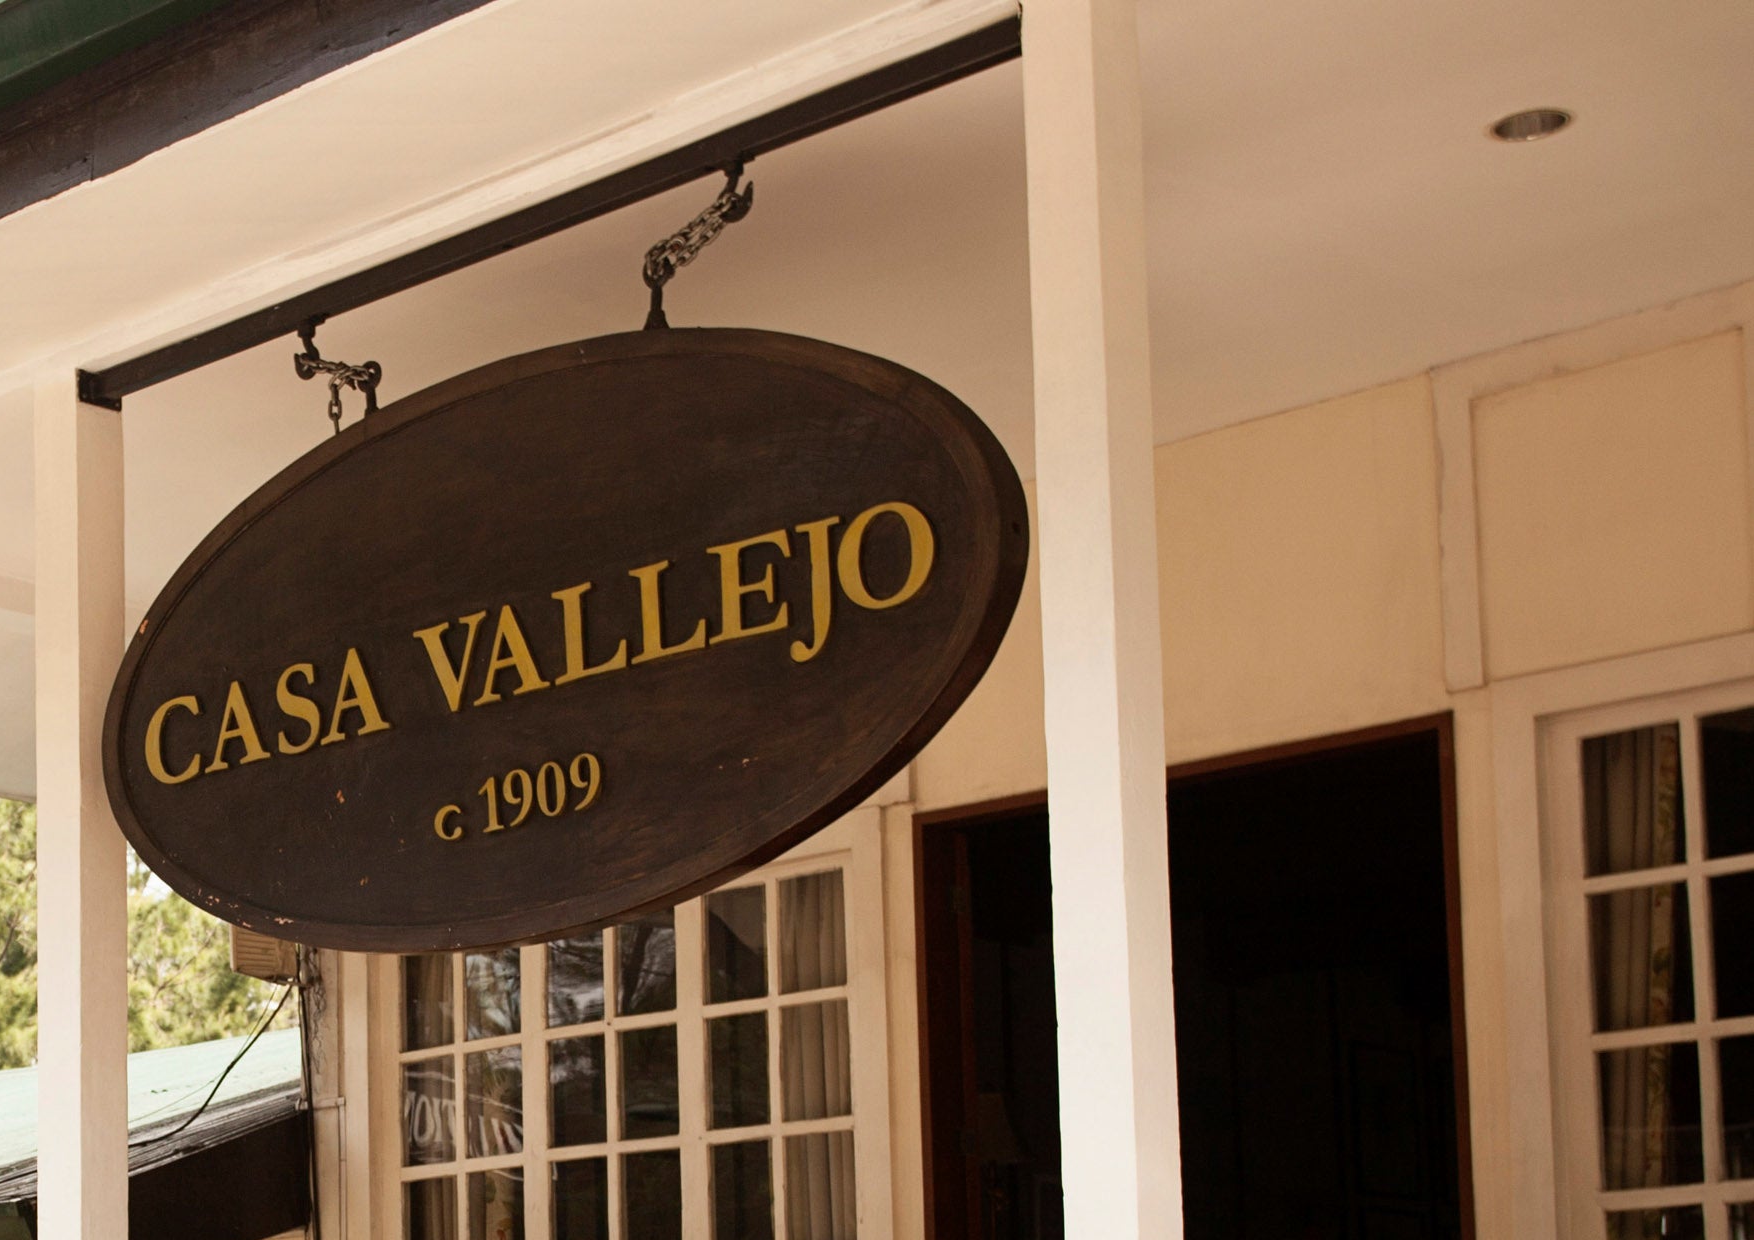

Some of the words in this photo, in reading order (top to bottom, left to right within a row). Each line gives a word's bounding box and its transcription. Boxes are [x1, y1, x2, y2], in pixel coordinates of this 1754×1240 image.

[143, 648, 391, 785] CASA
[412, 501, 936, 713] VALLEJO
[434, 803, 463, 841] c
[477, 752, 602, 835] 1909
